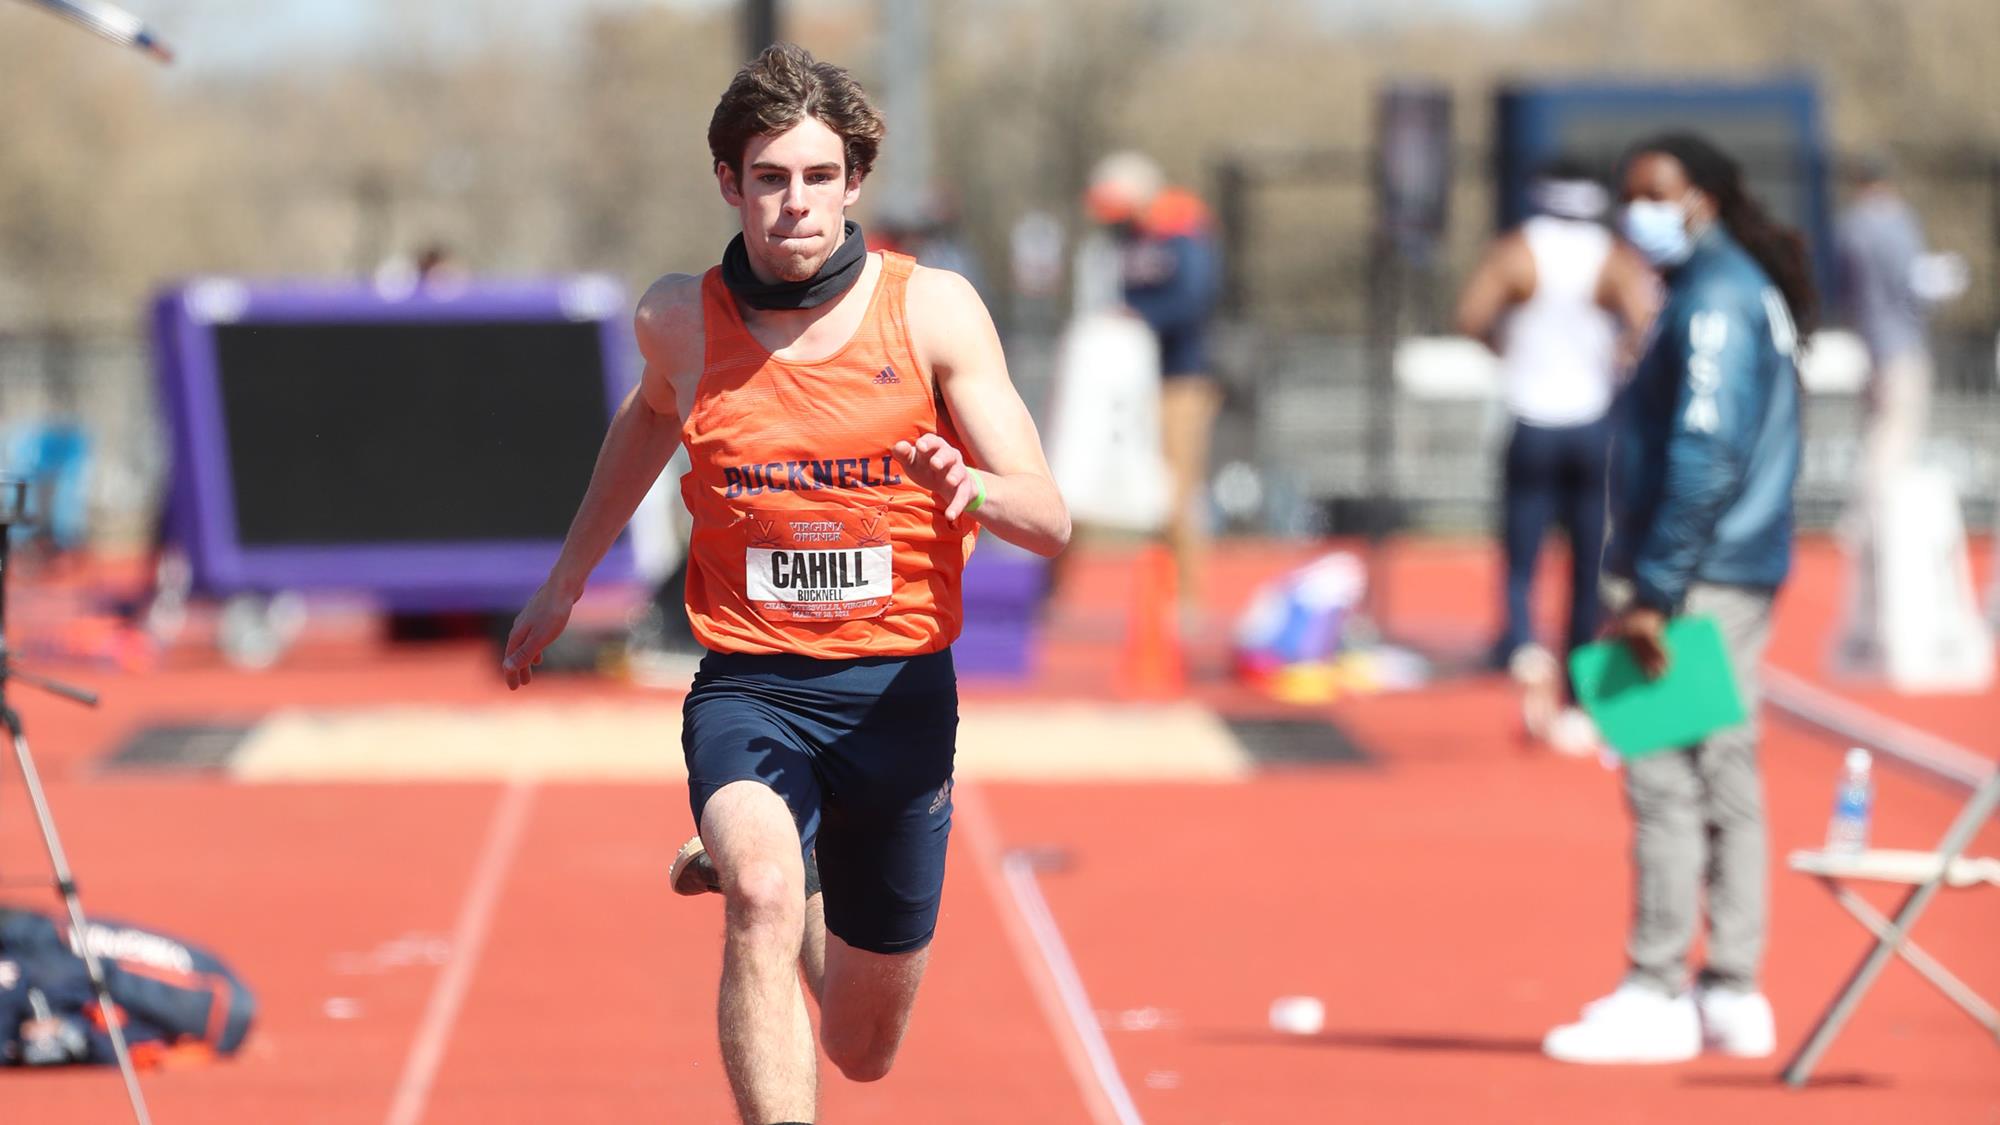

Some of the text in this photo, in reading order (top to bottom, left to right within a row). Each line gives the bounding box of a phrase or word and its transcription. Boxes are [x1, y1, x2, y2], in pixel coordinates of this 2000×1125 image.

[724, 456, 901, 499] BUCKNELL
[789, 521, 844, 532] VIRGINIA
[793, 532, 841, 542] OPENER
[771, 551, 869, 589] CAHILL
[798, 589, 843, 601] BUCKNELL
[842, 600, 878, 609] VIRGINIA
